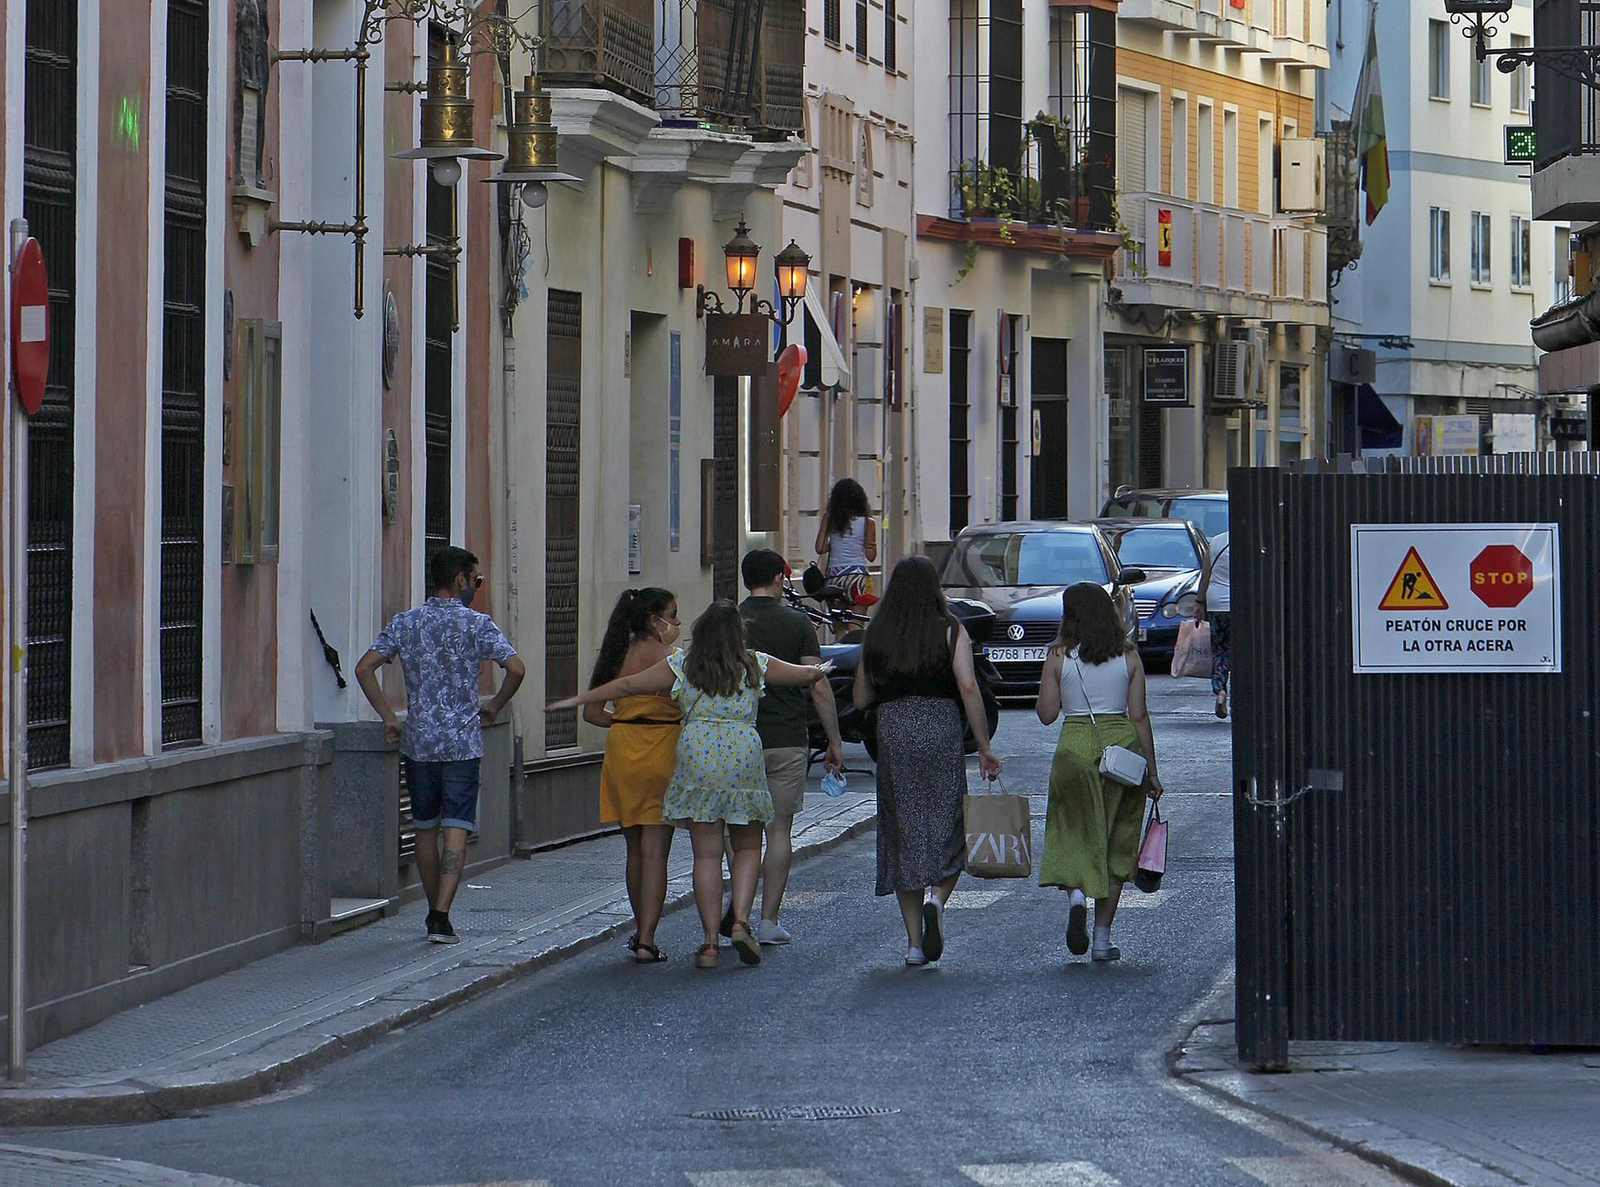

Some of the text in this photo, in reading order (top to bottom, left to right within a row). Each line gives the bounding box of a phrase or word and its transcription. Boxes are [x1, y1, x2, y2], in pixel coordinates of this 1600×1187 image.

[1474, 572, 1528, 585] STOP
[1386, 617, 1527, 632] PEATÓN CRUCE POR
[1403, 639, 1514, 652] LA OTRA ACERA
[991, 648, 1046, 660] 6768 FYZ
